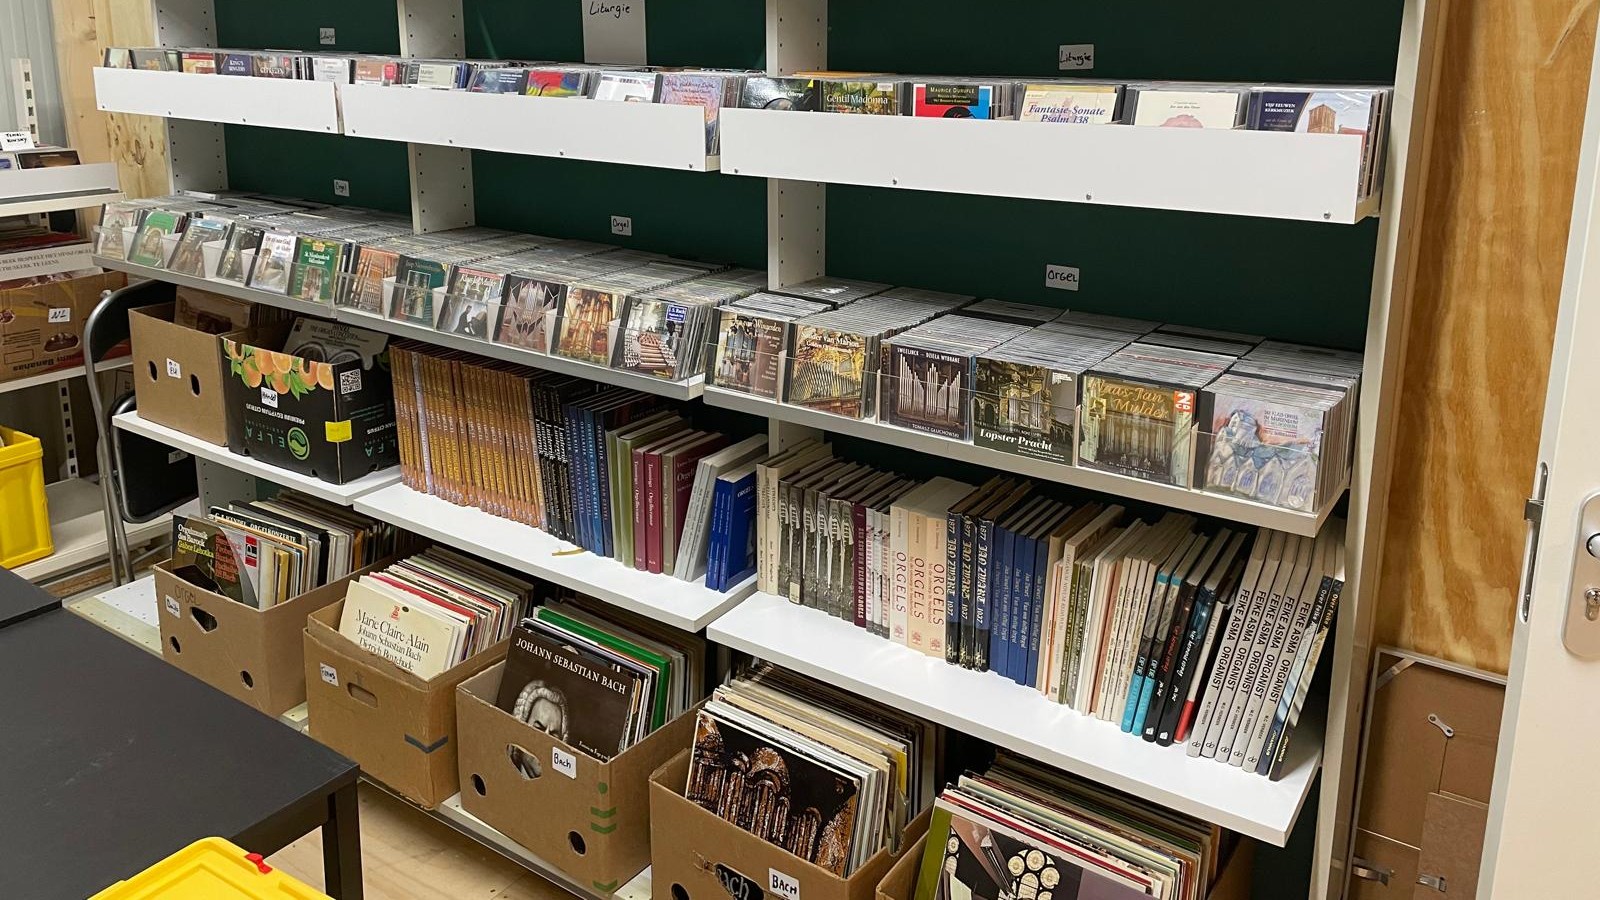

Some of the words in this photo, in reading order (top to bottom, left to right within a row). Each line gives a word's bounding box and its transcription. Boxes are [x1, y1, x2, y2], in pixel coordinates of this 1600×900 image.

[589, 1, 631, 18] Liturgie
[1059, 51, 1092, 66] Liturgie
[826, 94, 849, 104] Gentil
[850, 94, 888, 105] Madonna
[1029, 104, 1106, 116] Fantasie-Sonate
[1041, 114, 1070, 124] Psalm
[1072, 115, 1090, 124] 138
[612, 217, 632, 231] Orgel
[1177, 392, 1191, 404] 2
[244, 426, 286, 448] ELFA
[912, 423, 930, 432] TOMASZ
[979, 428, 1017, 443] Lopster
[1017, 435, 1053, 452] Pracht
[896, 552, 907, 613] ORGELS
[914, 558, 925, 618] ORGELS
[933, 563, 945, 625] ORGELS
[1235, 588, 1250, 616] FEIKE
[1251, 590, 1267, 618] FEIKE
[1265, 593, 1281, 621] FEIKE
[1279, 596, 1295, 625] FEIKE
[1296, 601, 1311, 629] FEIKE
[356, 608, 379, 631] Marie
[379, 620, 406, 643] Claire
[406, 633, 430, 655] Alain
[1226, 616, 1242, 641] ASMA
[1242, 617, 1256, 642] ASMA
[1256, 620, 1271, 646] ASMA
[1270, 623, 1285, 649] ASMA
[1286, 629, 1301, 654] ASMA
[357, 624, 378, 641] Johann
[379, 634, 406, 656] Sebastian
[405, 645, 422, 663] Bach
[515, 637, 552, 661] JOHANN
[552, 653, 600, 683] SEBASTIAN
[600, 675, 626, 695] BACH
[1212, 646, 1232, 691] ORGANIST
[1226, 647, 1247, 692] ORGANIST
[1240, 650, 1262, 695] ORGANIST
[1254, 654, 1275, 700] ORGANIST
[1269, 660, 1291, 705] ORGANIST
[553, 752, 572, 770] Bach
